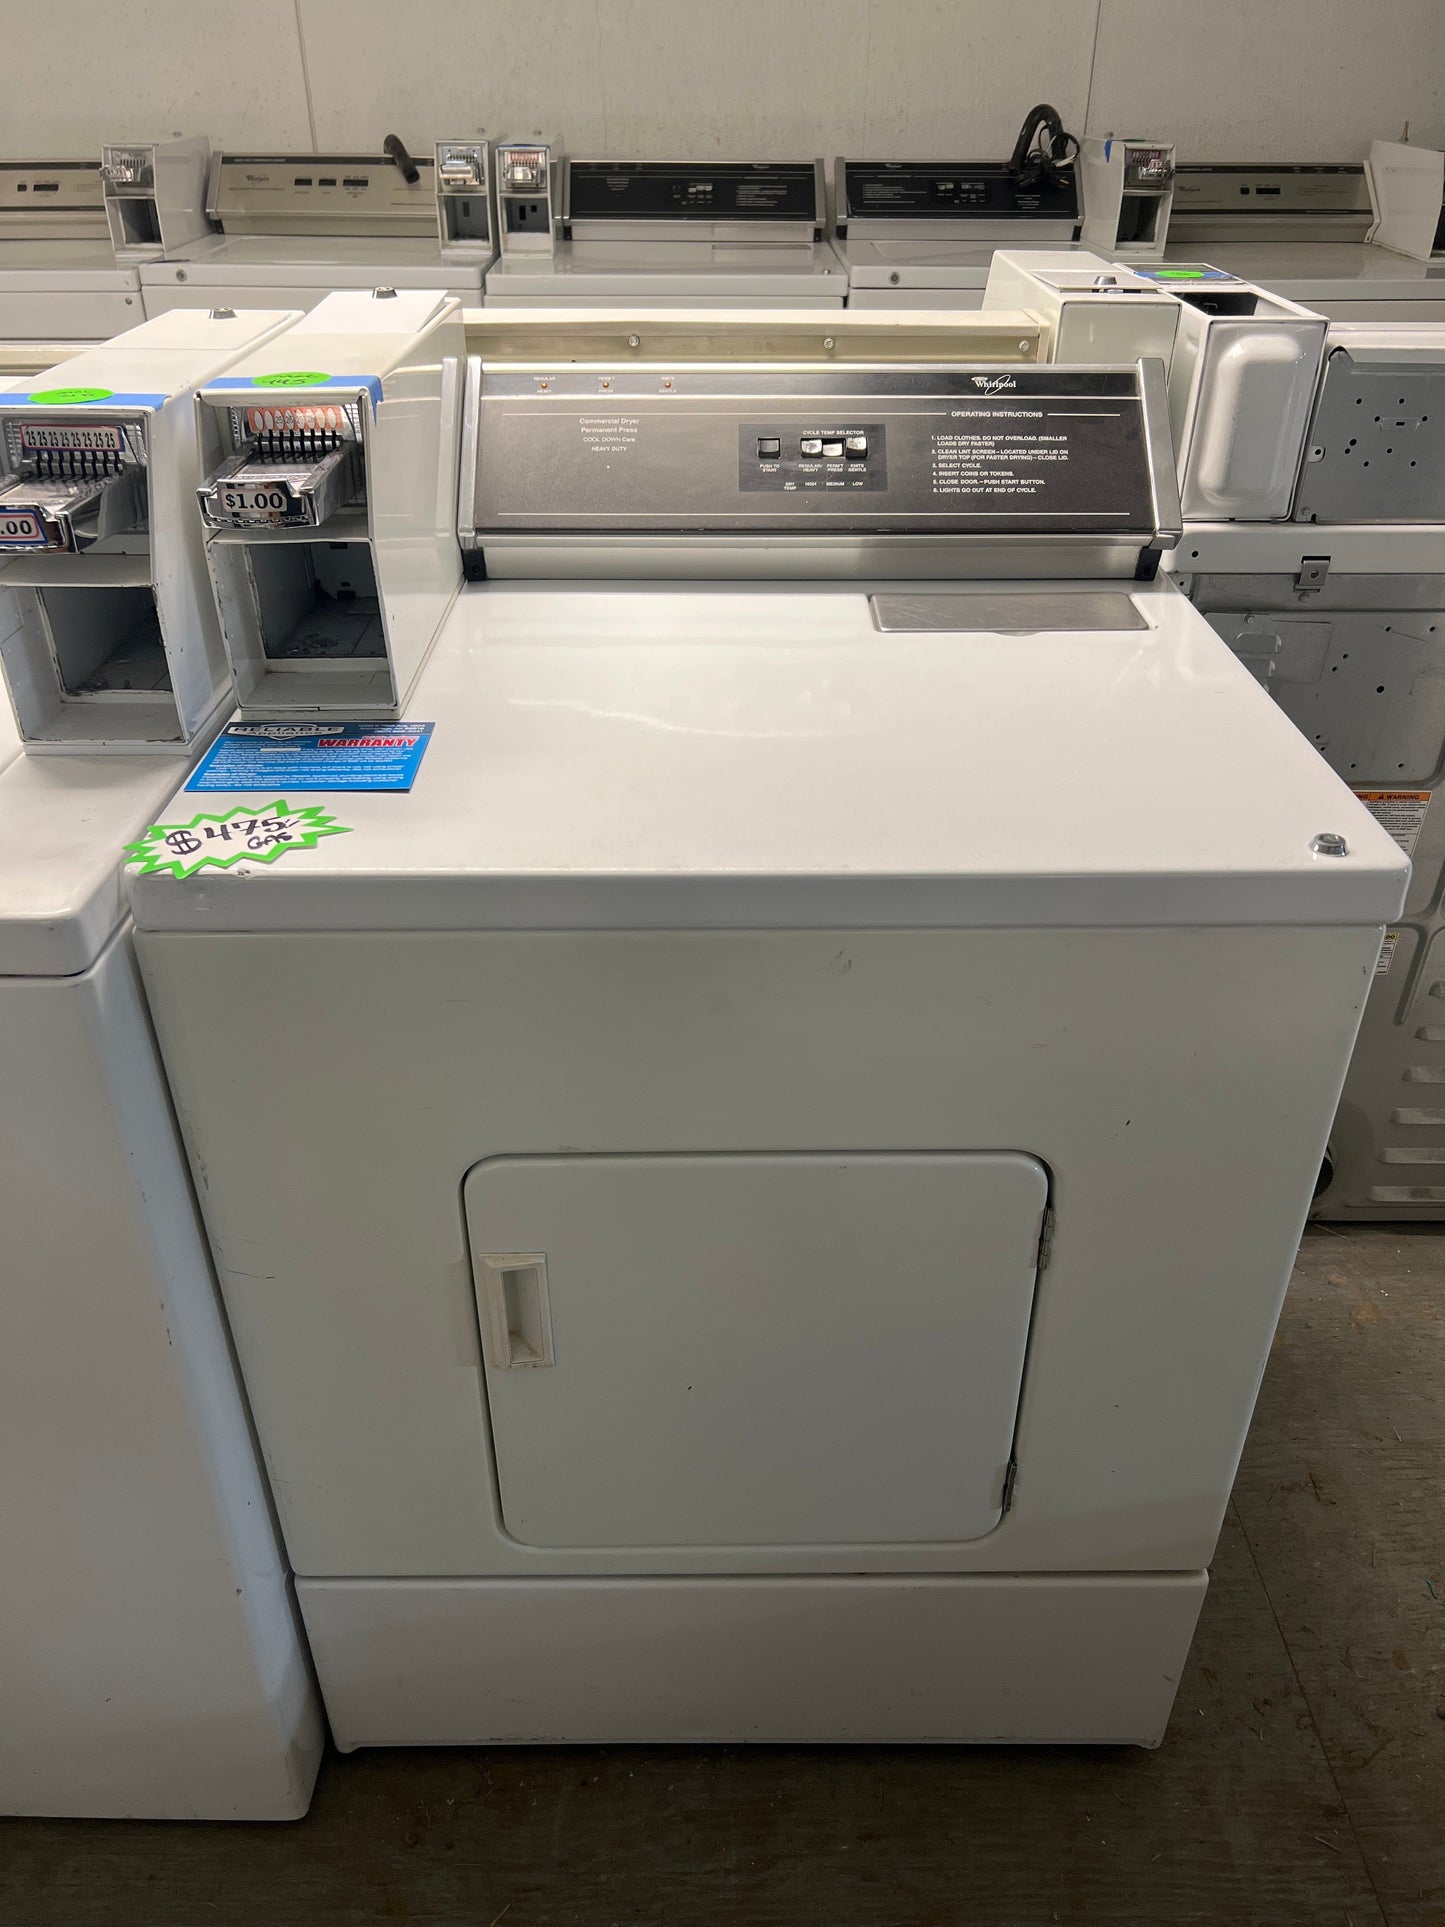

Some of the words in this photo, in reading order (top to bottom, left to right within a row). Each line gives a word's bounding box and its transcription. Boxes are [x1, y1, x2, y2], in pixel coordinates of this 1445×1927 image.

[973, 376, 1017, 391] Whirlpool
[26, 431, 36, 446] 25
[37, 431, 48, 446] 25
[49, 432, 59, 447] 25
[61, 432, 70, 447] 25
[71, 432, 81, 447] 25
[82, 432, 92, 447] 25
[93, 432, 104, 448] 25
[105, 432, 115, 448] 25
[226, 492, 283, 509] $1.00
[318, 738, 416, 747] WARRANTY
